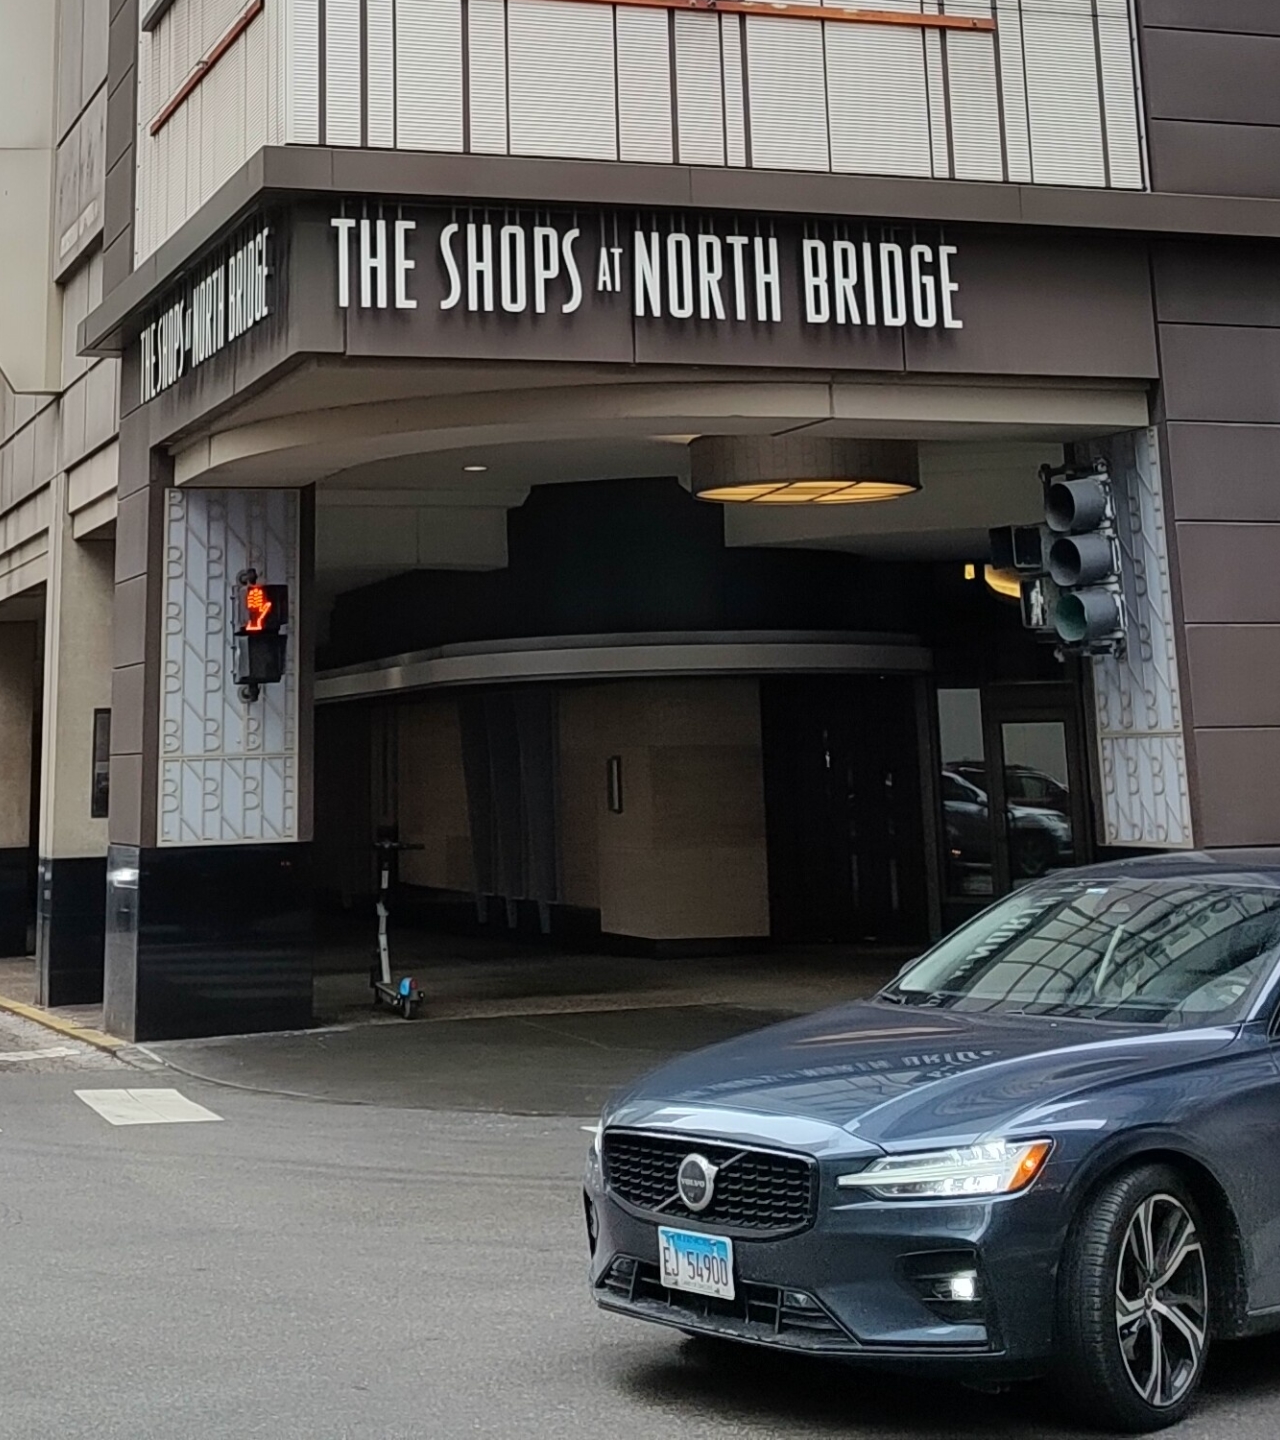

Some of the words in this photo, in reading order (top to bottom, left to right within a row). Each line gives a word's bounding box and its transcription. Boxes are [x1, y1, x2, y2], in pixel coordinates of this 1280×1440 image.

[140, 322, 157, 405] THE
[192, 263, 225, 369] NORTH
[228, 226, 269, 342] BRIDGE
[330, 217, 417, 310] THE
[439, 222, 582, 315] SHOPS
[597, 246, 623, 293] AT
[634, 230, 782, 323] NORTH
[802, 237, 963, 329] BRIDGE
[663, 1246, 679, 1277] EJ
[686, 1251, 729, 1287] 54900
